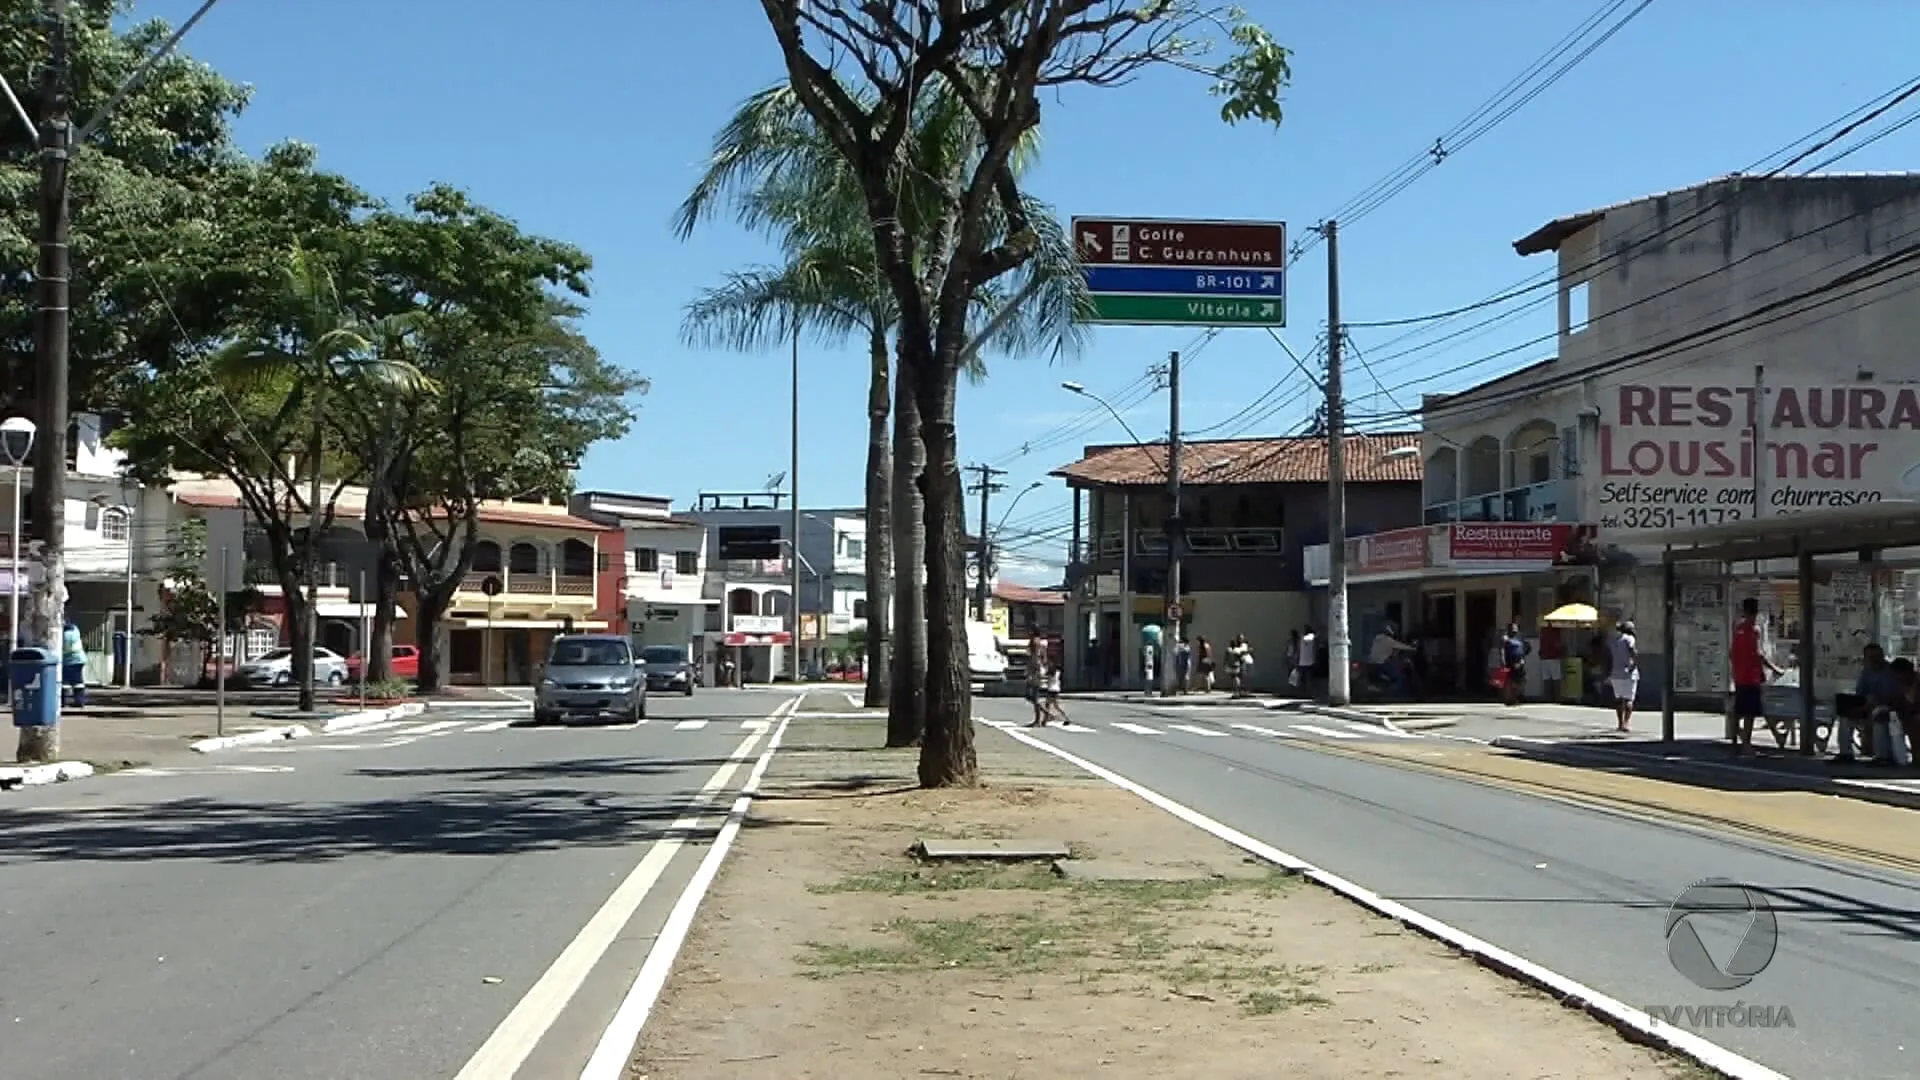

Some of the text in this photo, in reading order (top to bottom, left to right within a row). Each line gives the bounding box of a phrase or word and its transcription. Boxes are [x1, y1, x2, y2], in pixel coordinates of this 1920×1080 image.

[1139, 228, 1185, 242] Golfe
[1139, 246, 1272, 262] C. Guaranhuns
[1196, 275, 1251, 289] BR-101
[1619, 385, 1920, 429] RESTAURA
[1716, 489, 1756, 504] com
[1770, 485, 1881, 507] churrasco
[1455, 525, 1552, 541] Restaurante
